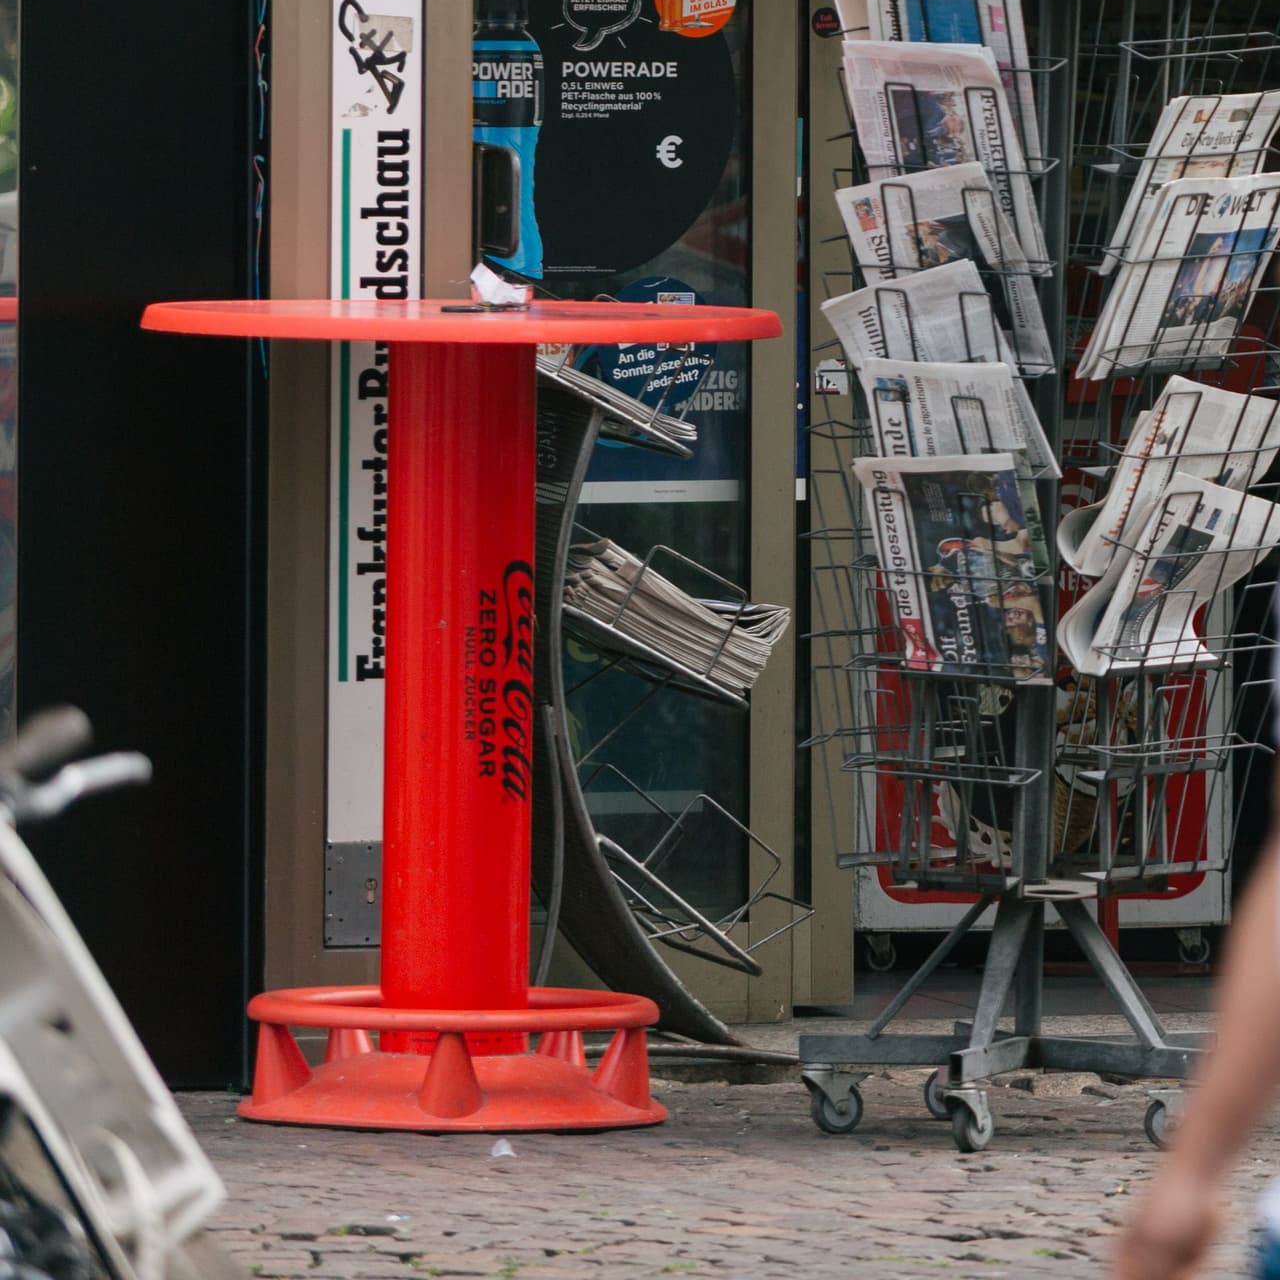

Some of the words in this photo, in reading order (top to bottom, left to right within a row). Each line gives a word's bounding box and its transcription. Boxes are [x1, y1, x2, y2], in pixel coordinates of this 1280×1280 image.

[573, 3, 627, 12] ERFRISCHEN!
[472, 62, 534, 80] POWER
[562, 61, 678, 78] POWERADE
[497, 80, 534, 98] ADE
[561, 92, 617, 100] PET-Flasche
[585, 82, 624, 90] EINWEG
[656, 134, 684, 170] €
[869, 233, 896, 280] itung
[858, 305, 888, 359] eitung
[612, 353, 712, 380] Sonntaszetung
[618, 353, 635, 365] An
[637, 349, 656, 361] die
[884, 416, 908, 457] nde
[871, 469, 908, 585] tageszeitung
[898, 589, 913, 617] die
[479, 588, 497, 668] ZERO
[479, 677, 497, 779] SUGAR
